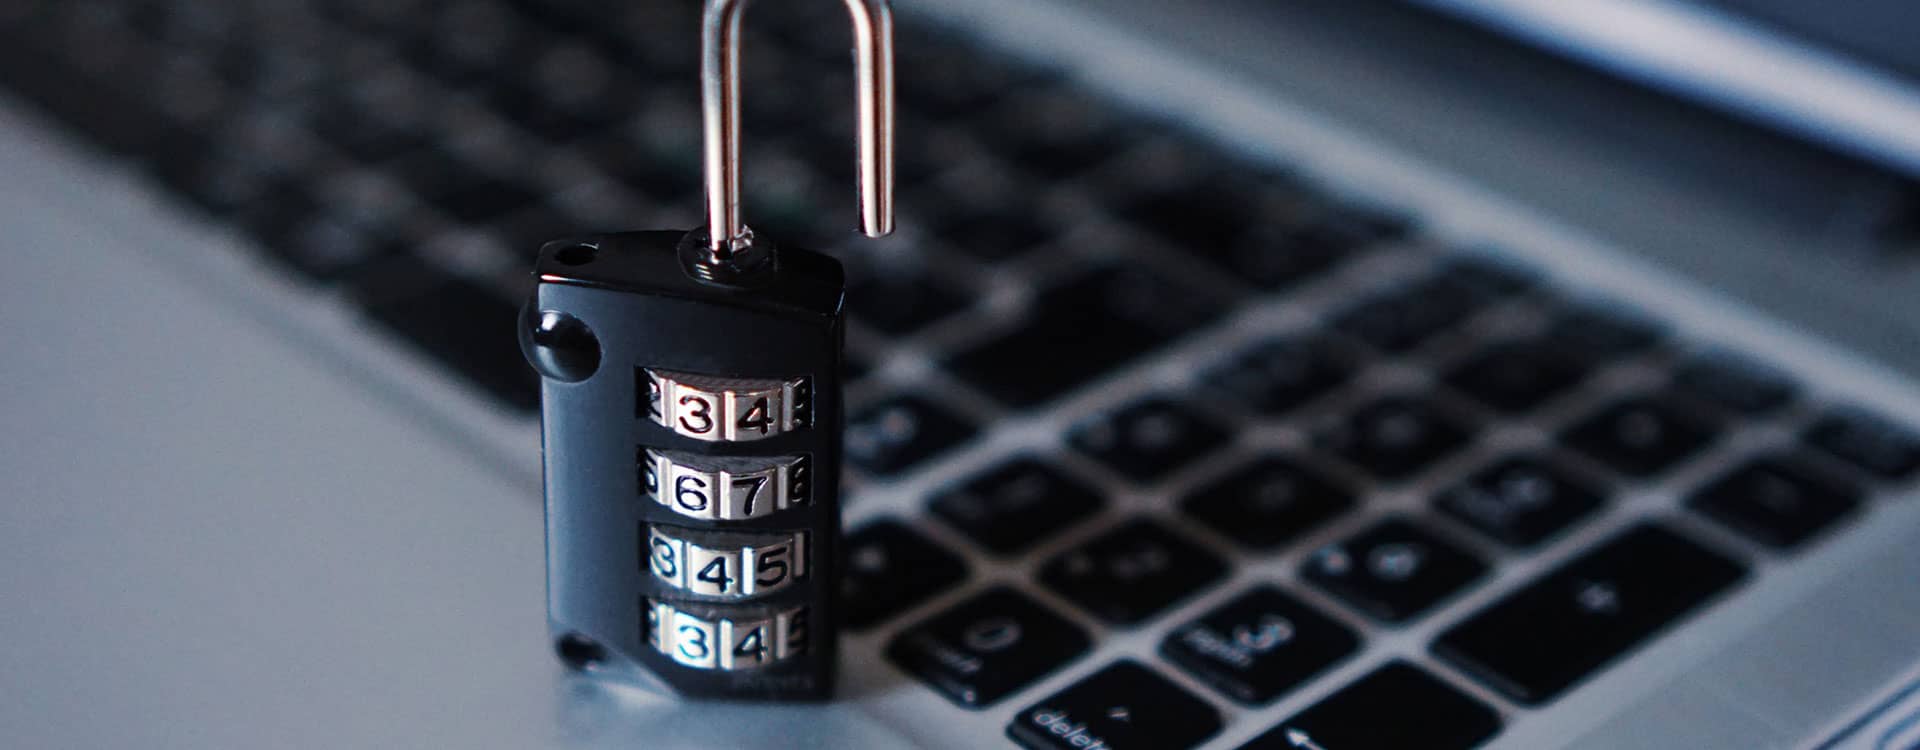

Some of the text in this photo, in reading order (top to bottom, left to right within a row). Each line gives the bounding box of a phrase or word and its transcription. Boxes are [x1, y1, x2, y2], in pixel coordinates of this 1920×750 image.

[679, 395, 714, 433] 3
[737, 397, 775, 435] 4
[675, 475, 707, 511] 6
[732, 476, 769, 515] 7
[651, 537, 788, 592] 3 4 5
[679, 625, 709, 659] 3
[734, 627, 769, 662] 4
[1034, 710, 1113, 750] delet
